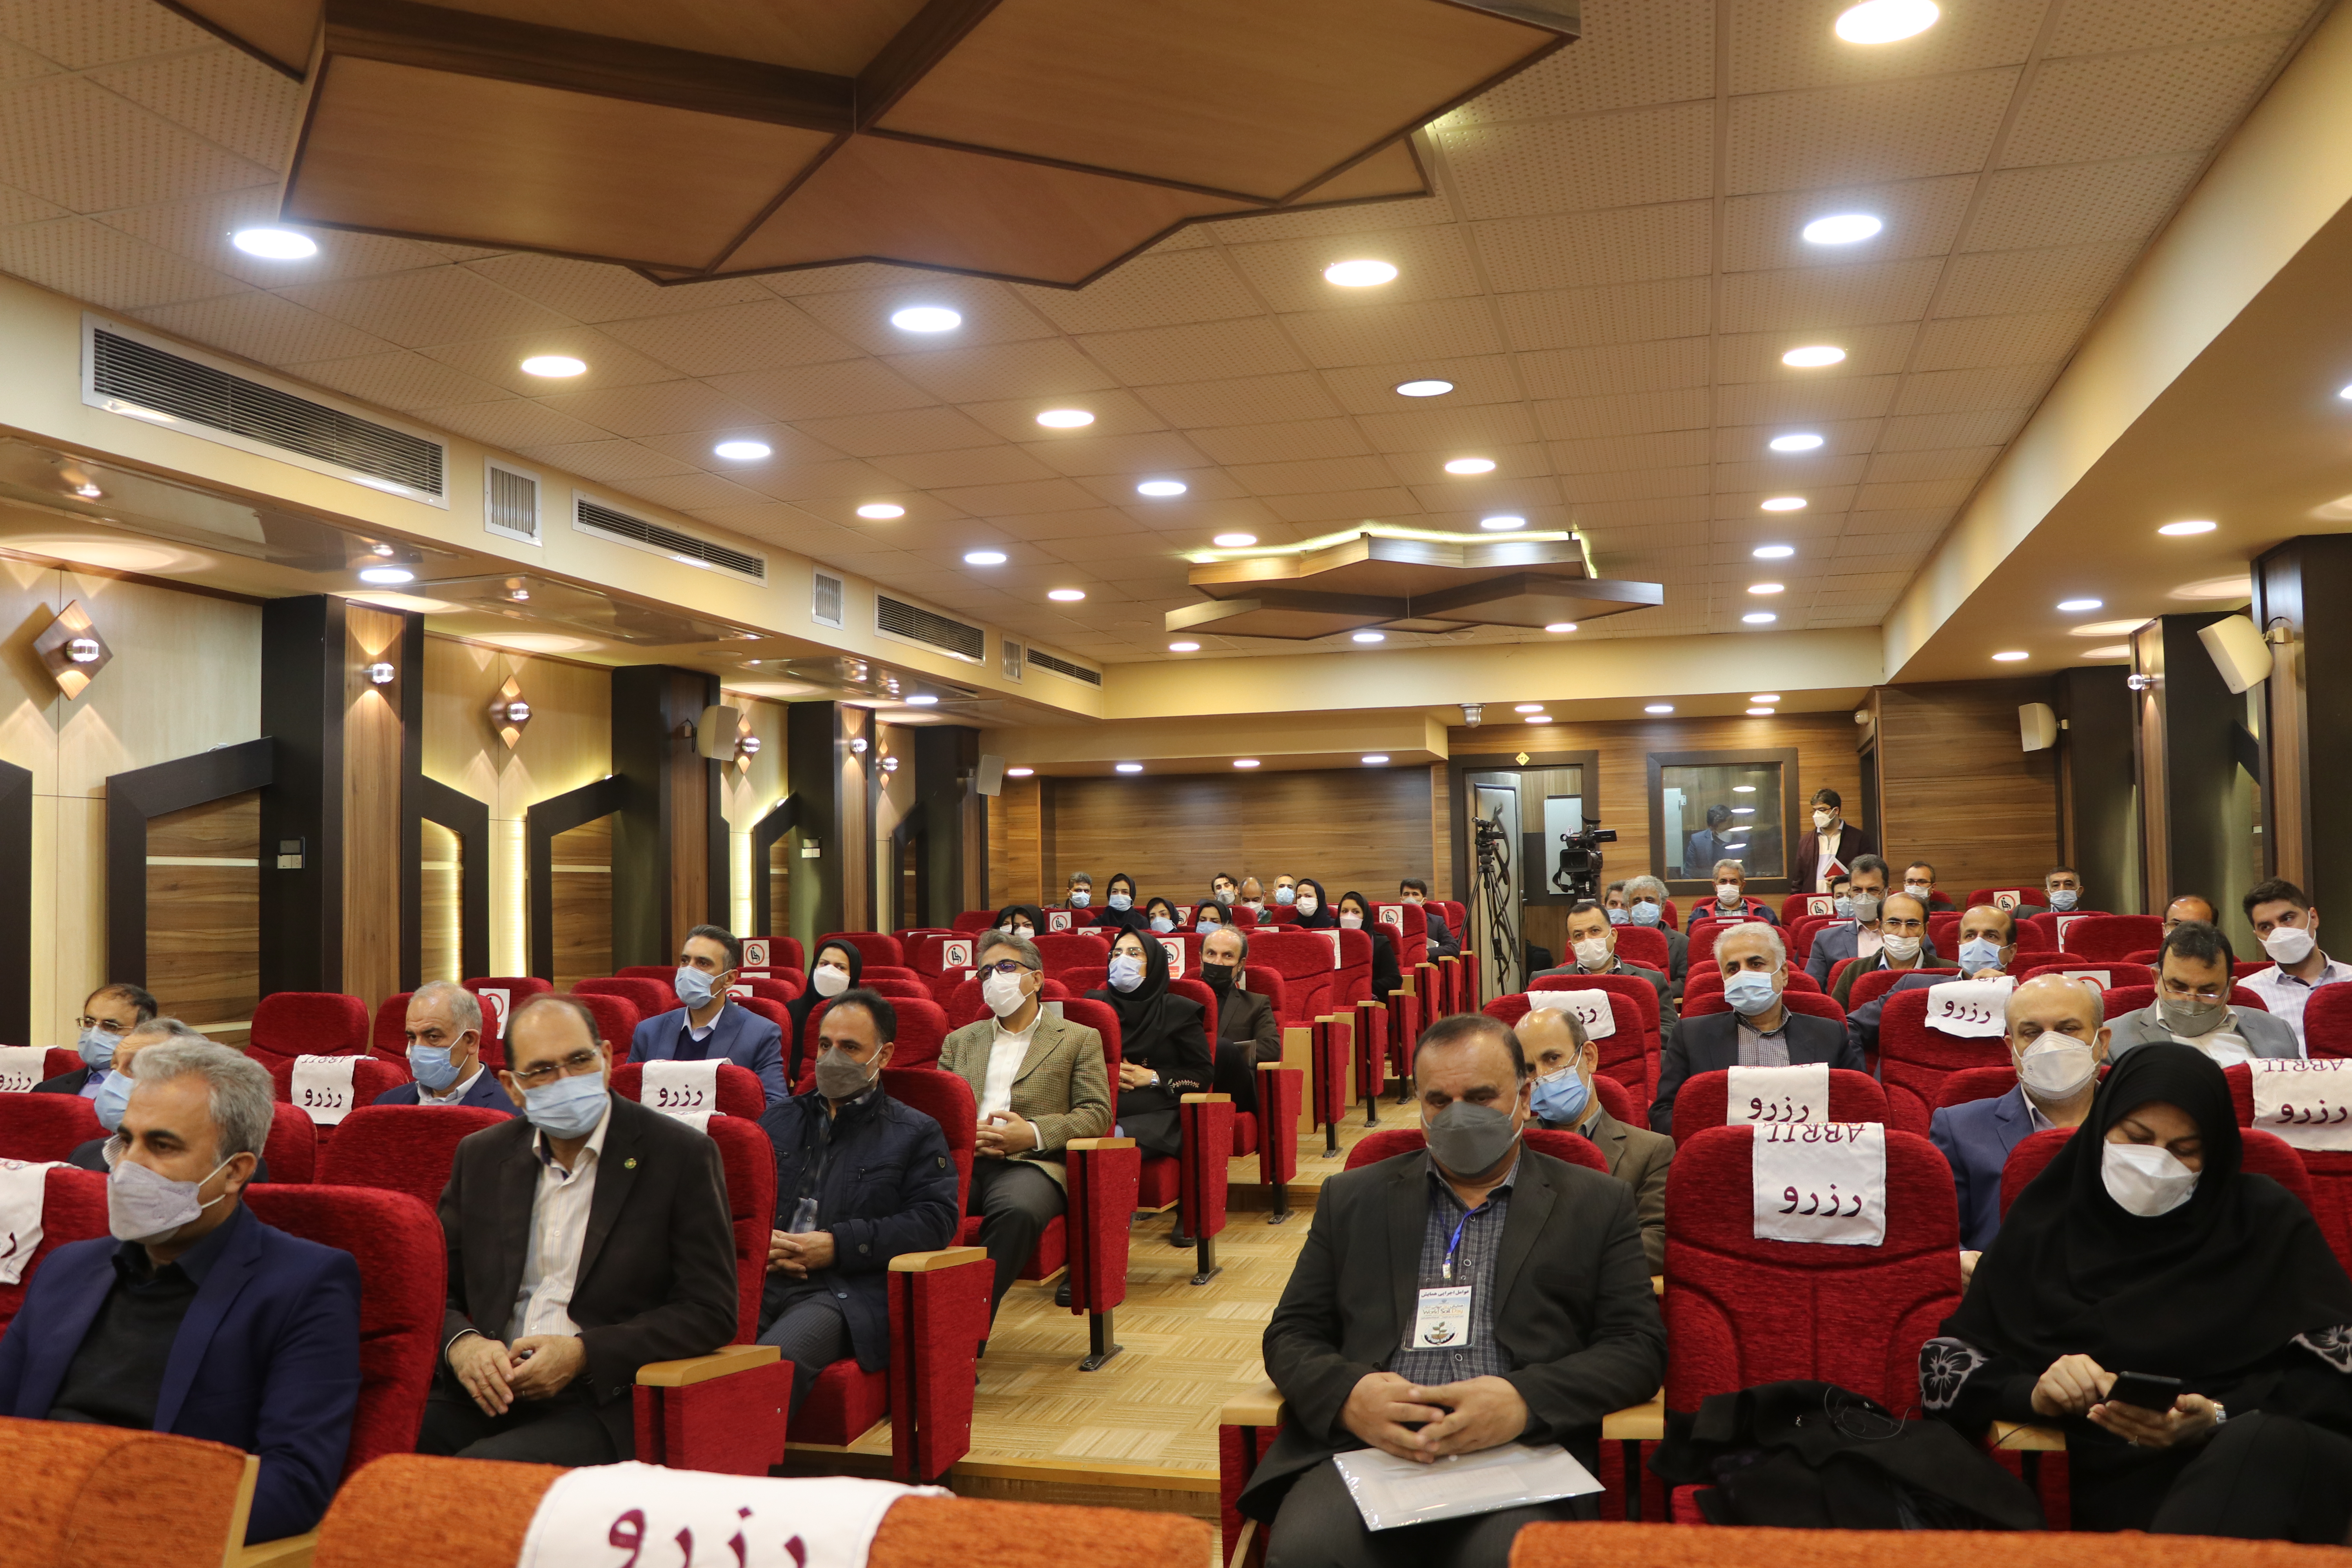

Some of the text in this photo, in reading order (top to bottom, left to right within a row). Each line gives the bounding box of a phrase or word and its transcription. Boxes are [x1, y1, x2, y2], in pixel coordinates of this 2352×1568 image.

[1576, 1006, 1597, 1025] رز
[1941, 1001, 1990, 1024] رزرو
[304, 1087, 342, 1107] رزرو
[657, 1084, 703, 1107] رزرو
[1747, 1096, 1809, 1122] رزرو
[2276, 1099, 2347, 1124] رزرو
[1779, 1183, 1862, 1217] رزرو
